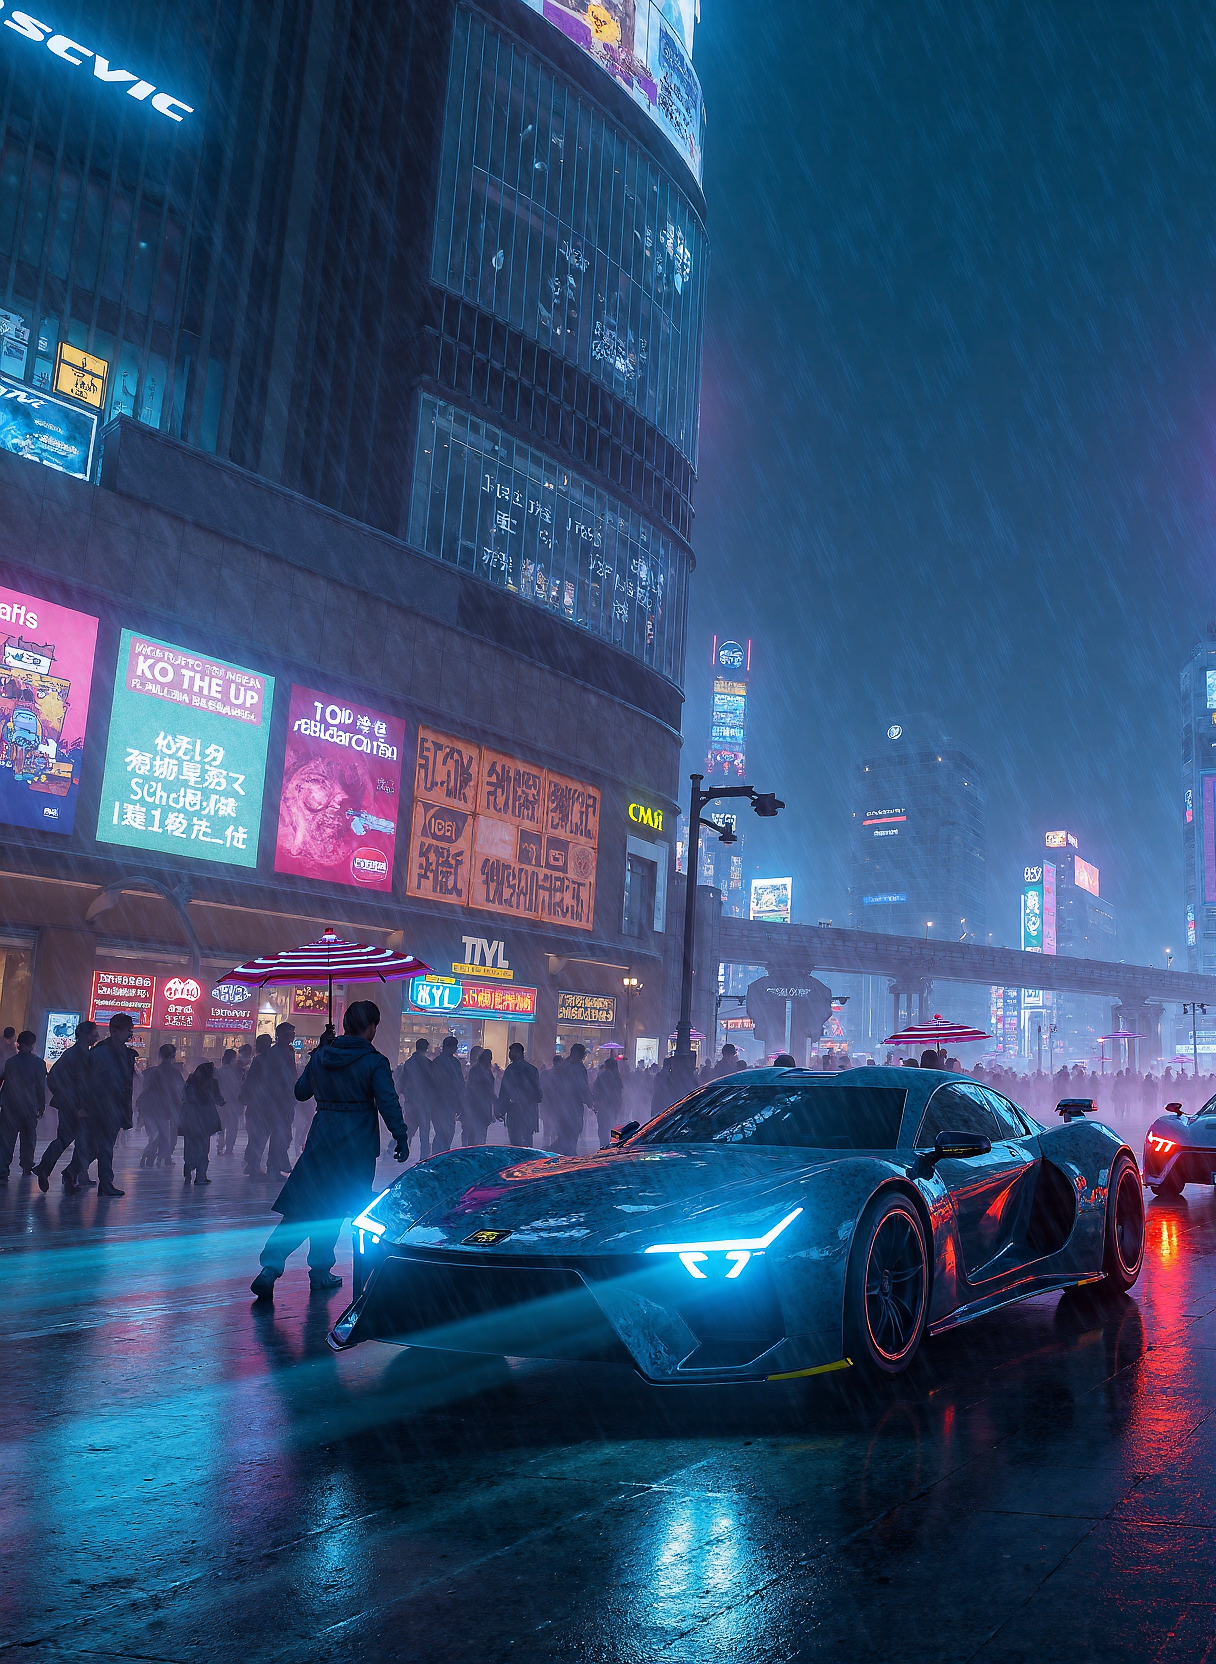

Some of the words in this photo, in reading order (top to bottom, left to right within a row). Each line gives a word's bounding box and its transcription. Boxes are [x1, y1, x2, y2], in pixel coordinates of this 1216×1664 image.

[0, 0, 194, 122] SCVIC
[136, 655, 174, 683] KO
[181, 668, 223, 699] THE
[230, 683, 259, 707] UP
